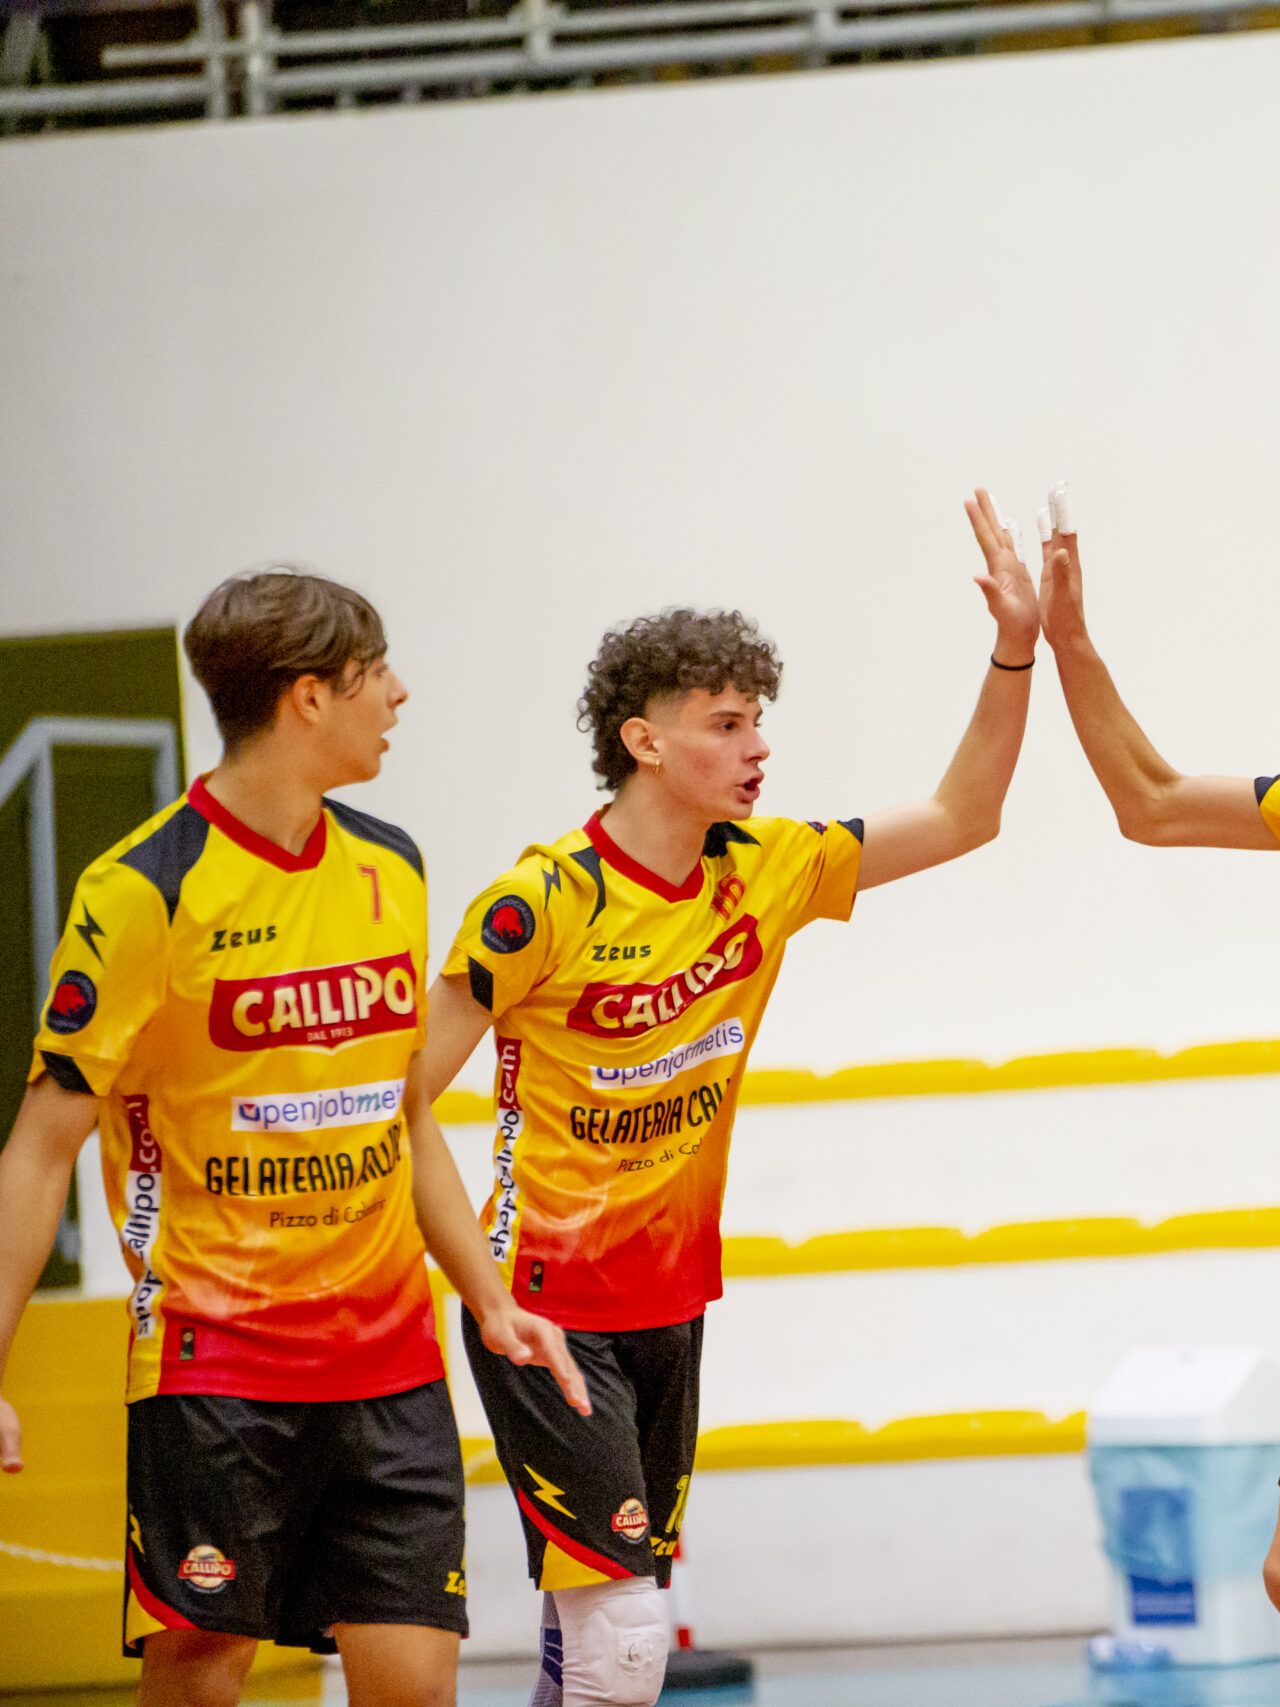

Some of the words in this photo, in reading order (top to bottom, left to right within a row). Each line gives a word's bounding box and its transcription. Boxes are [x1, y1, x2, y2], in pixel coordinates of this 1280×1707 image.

[210, 925, 278, 952] Zeus
[591, 944, 652, 962] Zeus
[231, 966, 415, 1038] CALLIPO
[570, 1104, 685, 1144] GELATERIA
[205, 1153, 355, 1197] GELATERIA
[269, 1211, 318, 1228] Pizzo
[322, 1206, 339, 1226] di
